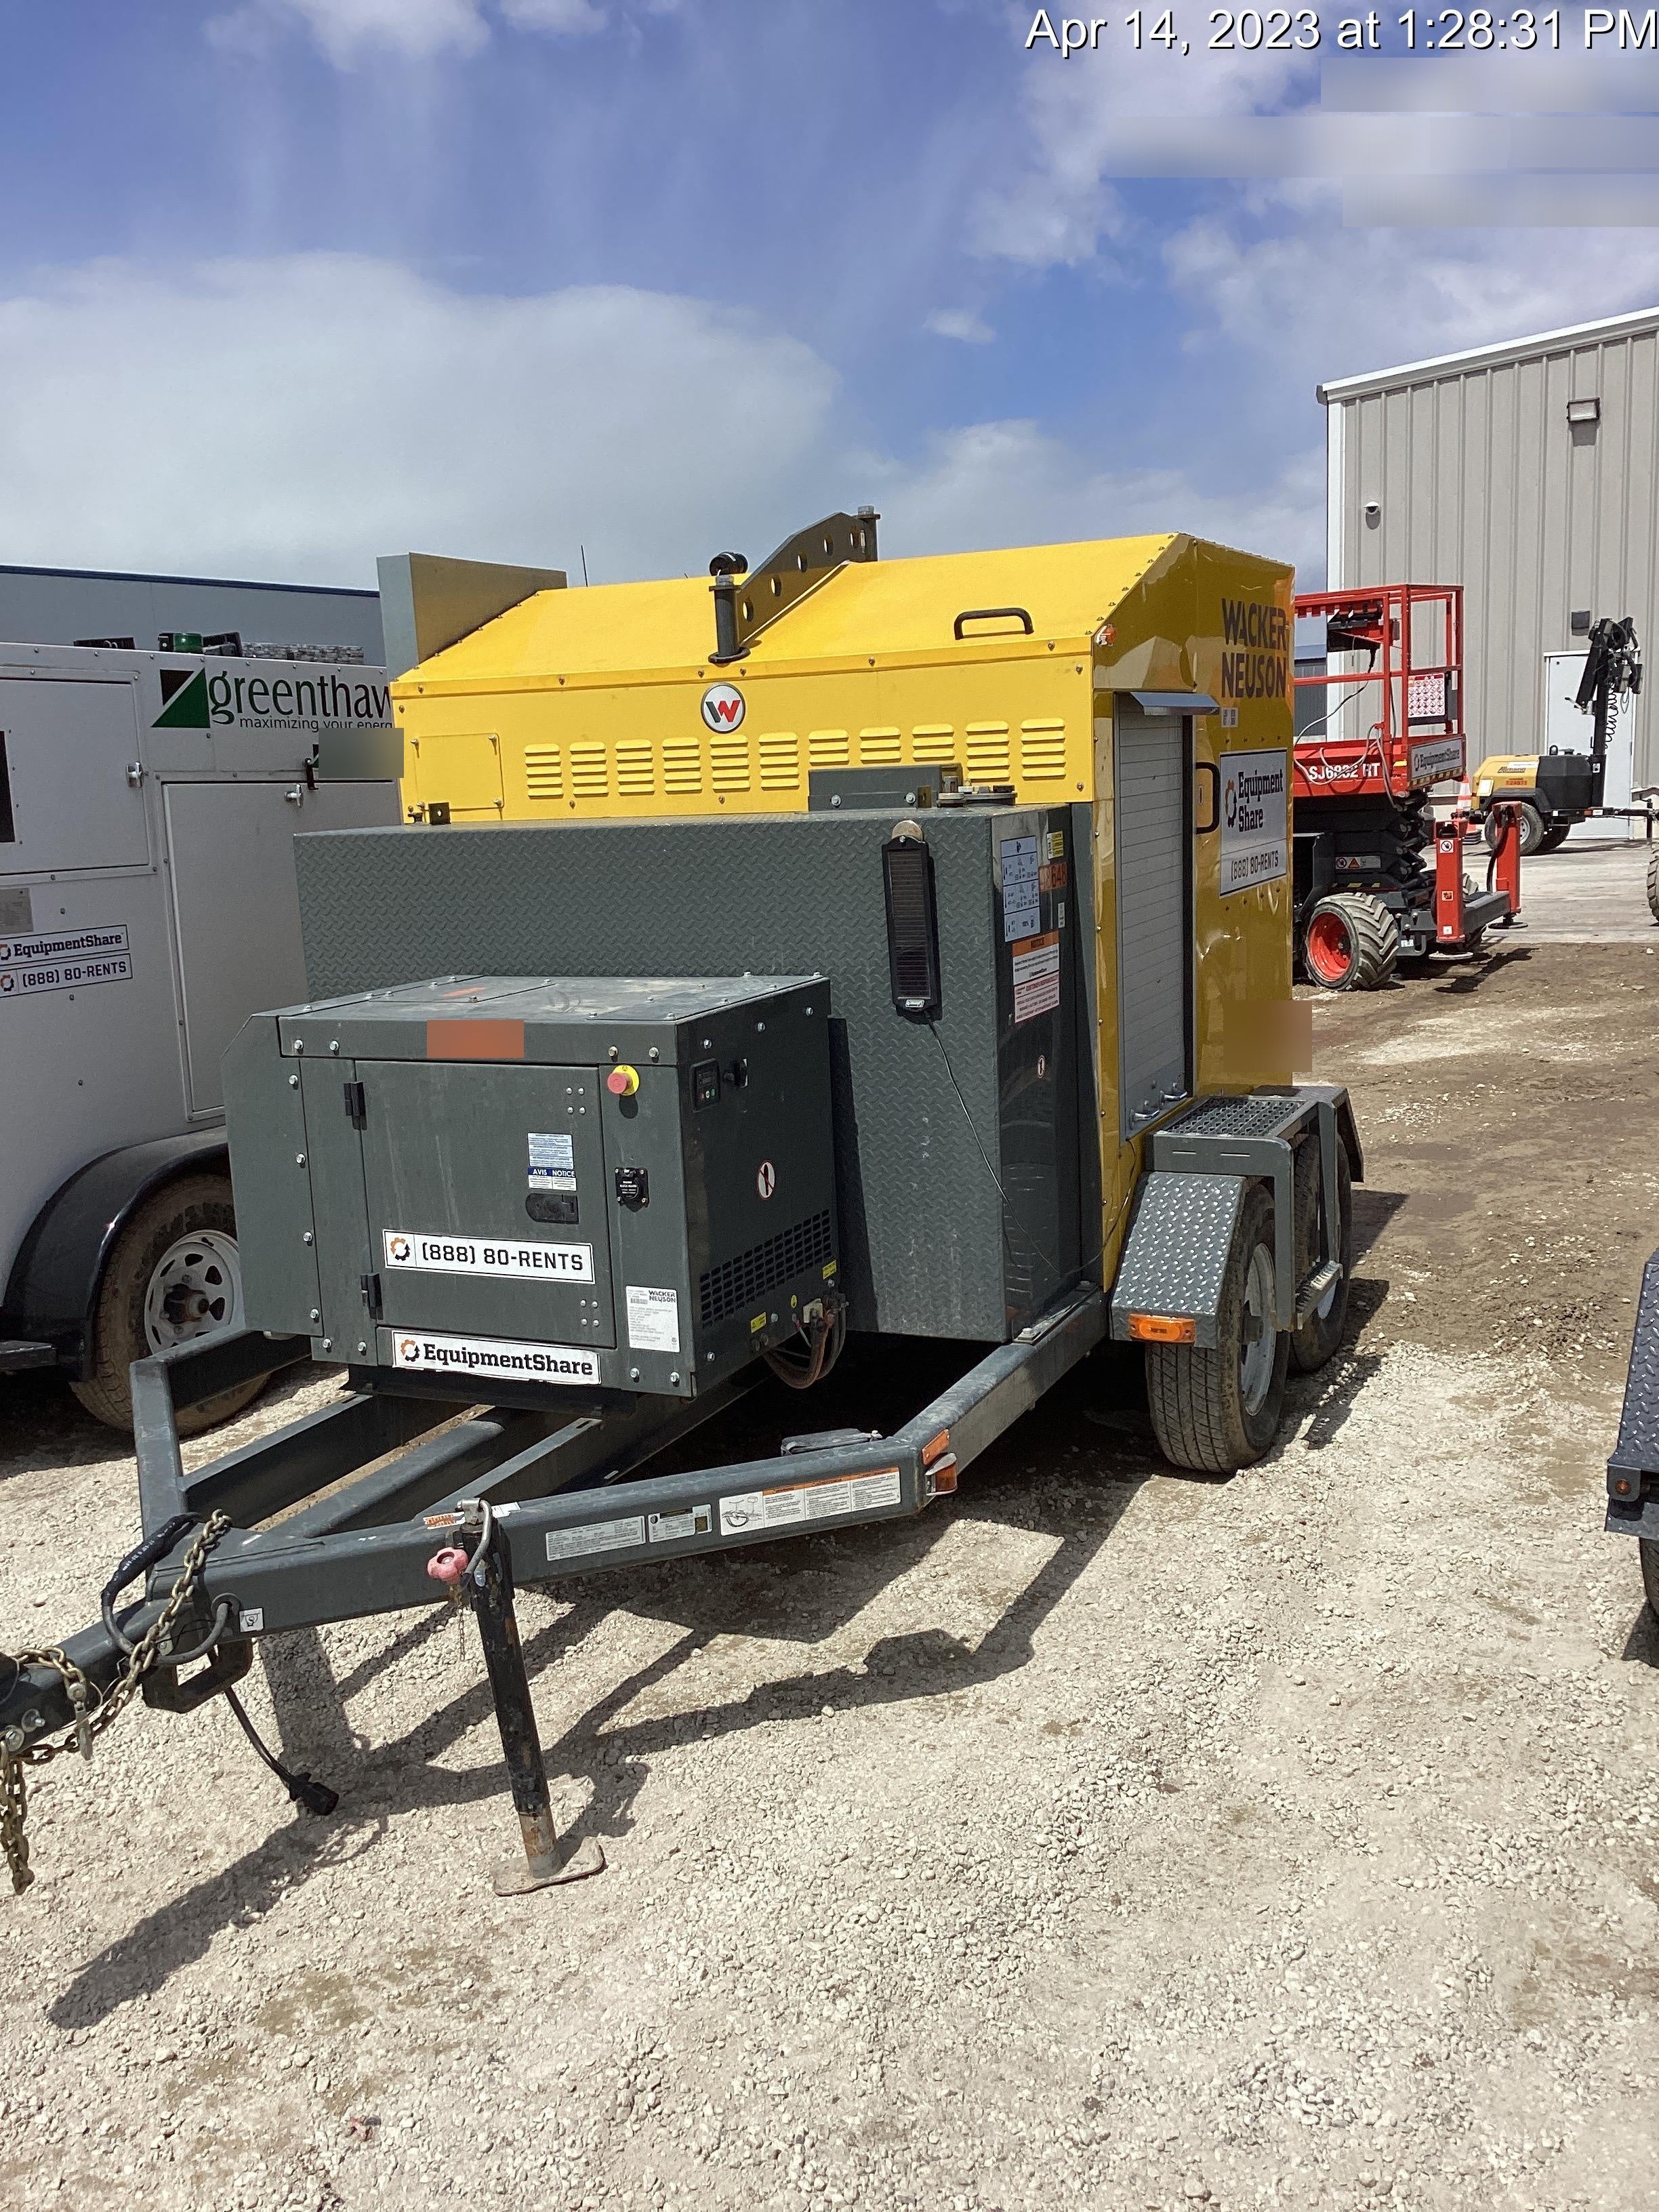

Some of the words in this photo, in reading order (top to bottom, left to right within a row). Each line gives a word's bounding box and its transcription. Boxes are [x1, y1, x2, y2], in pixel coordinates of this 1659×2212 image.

[1221, 598, 1287, 651] WACKER
[1221, 651, 1287, 699] NEUSON
[239, 715, 319, 733] maximizing
[1362, 762, 1380, 777] RT
[1238, 769, 1284, 804] Equipment
[1238, 805, 1264, 832] Share
[1231, 855, 1248, 882] (888)
[1250, 850, 1279, 874] 80-RENTS
[14, 934, 123, 958] EquipmentShare
[22, 969, 60, 987] (888)
[64, 961, 127, 981] 80-RENTS
[552, 1170, 575, 1178] NOTICE
[422, 1242, 476, 1265] (888)
[484, 1248, 583, 1271] 80-RENTS
[649, 1295, 676, 1303] NEUSON
[423, 1343, 593, 1376] EquipmentShare
